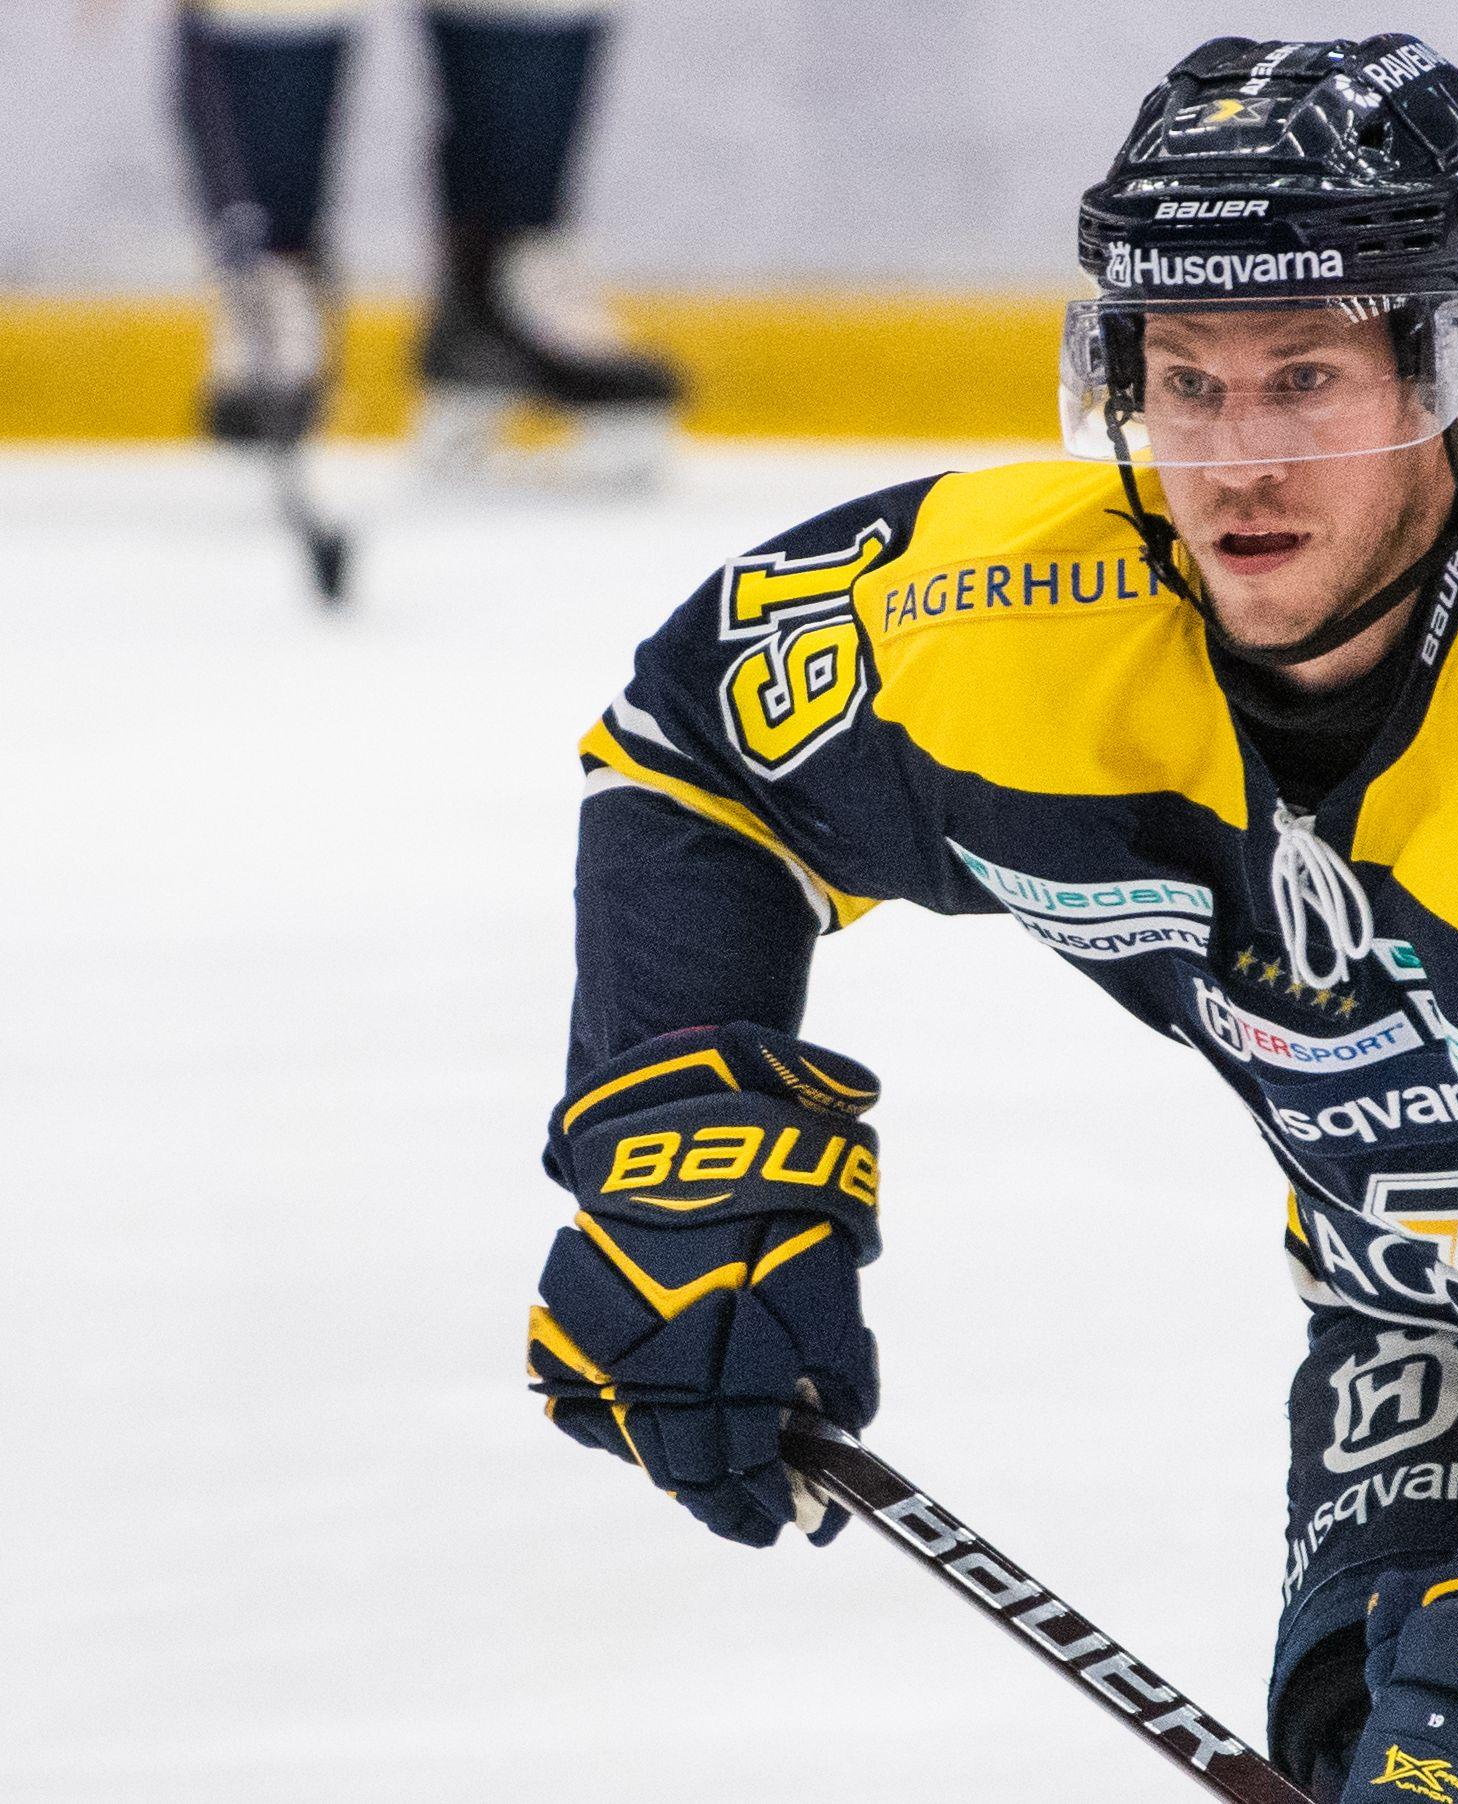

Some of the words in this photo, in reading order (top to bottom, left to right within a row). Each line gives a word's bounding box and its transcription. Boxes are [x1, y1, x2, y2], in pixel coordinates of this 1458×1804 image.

[1134, 249, 1344, 290] Husqvarna
[1154, 200, 1270, 219] BAUER
[719, 518, 894, 781] 19
[874, 1493, 1247, 1771] BAUER
